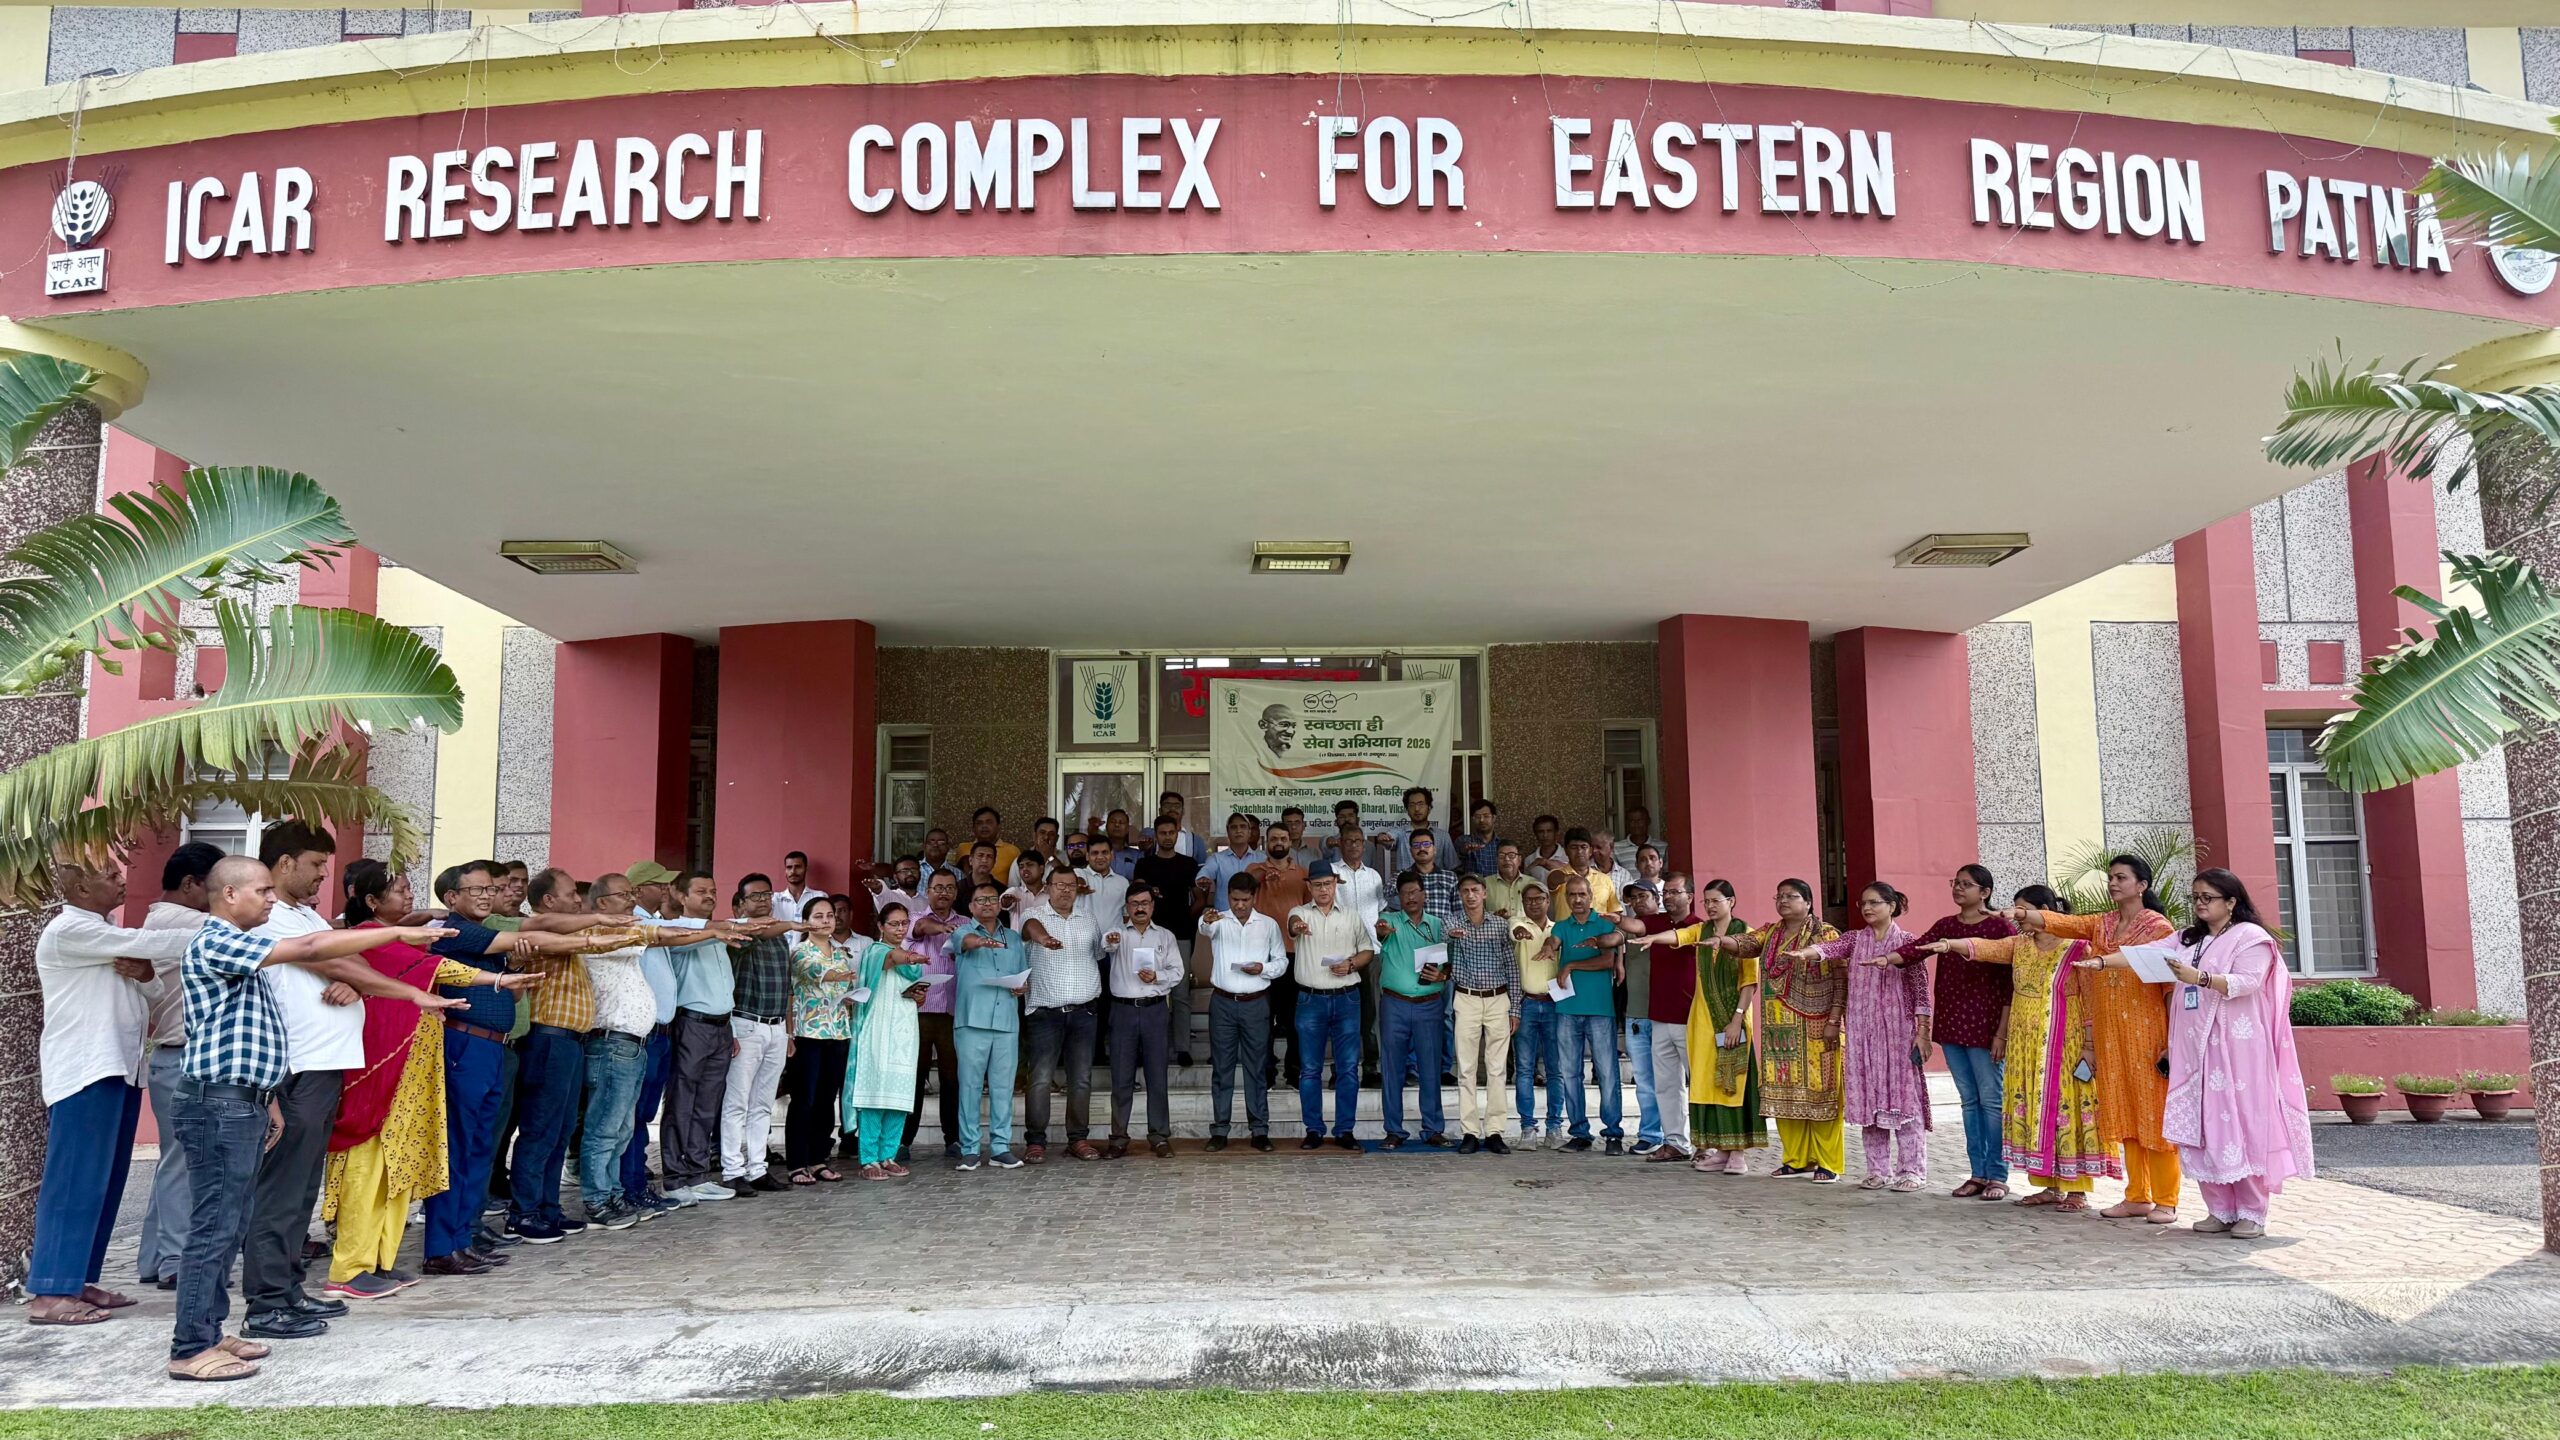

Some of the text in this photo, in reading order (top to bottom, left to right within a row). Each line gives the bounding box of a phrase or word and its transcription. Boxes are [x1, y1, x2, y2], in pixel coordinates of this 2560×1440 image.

[165, 115, 2453, 272] ICAR RESEARCH COMPLEX FOR EASTERN REGION PATNA
[52, 276, 97, 290] ICAR
[1303, 715, 1384, 732] स्वच्छता ही
[1302, 733, 1431, 749] सेवा अभियान 2026
[1267, 785, 1278, 797] में
[1319, 787, 1343, 797] स्वच्छ
[1361, 803, 1387, 814] Bharat,
[1361, 818, 1396, 830] अनुसंधान
